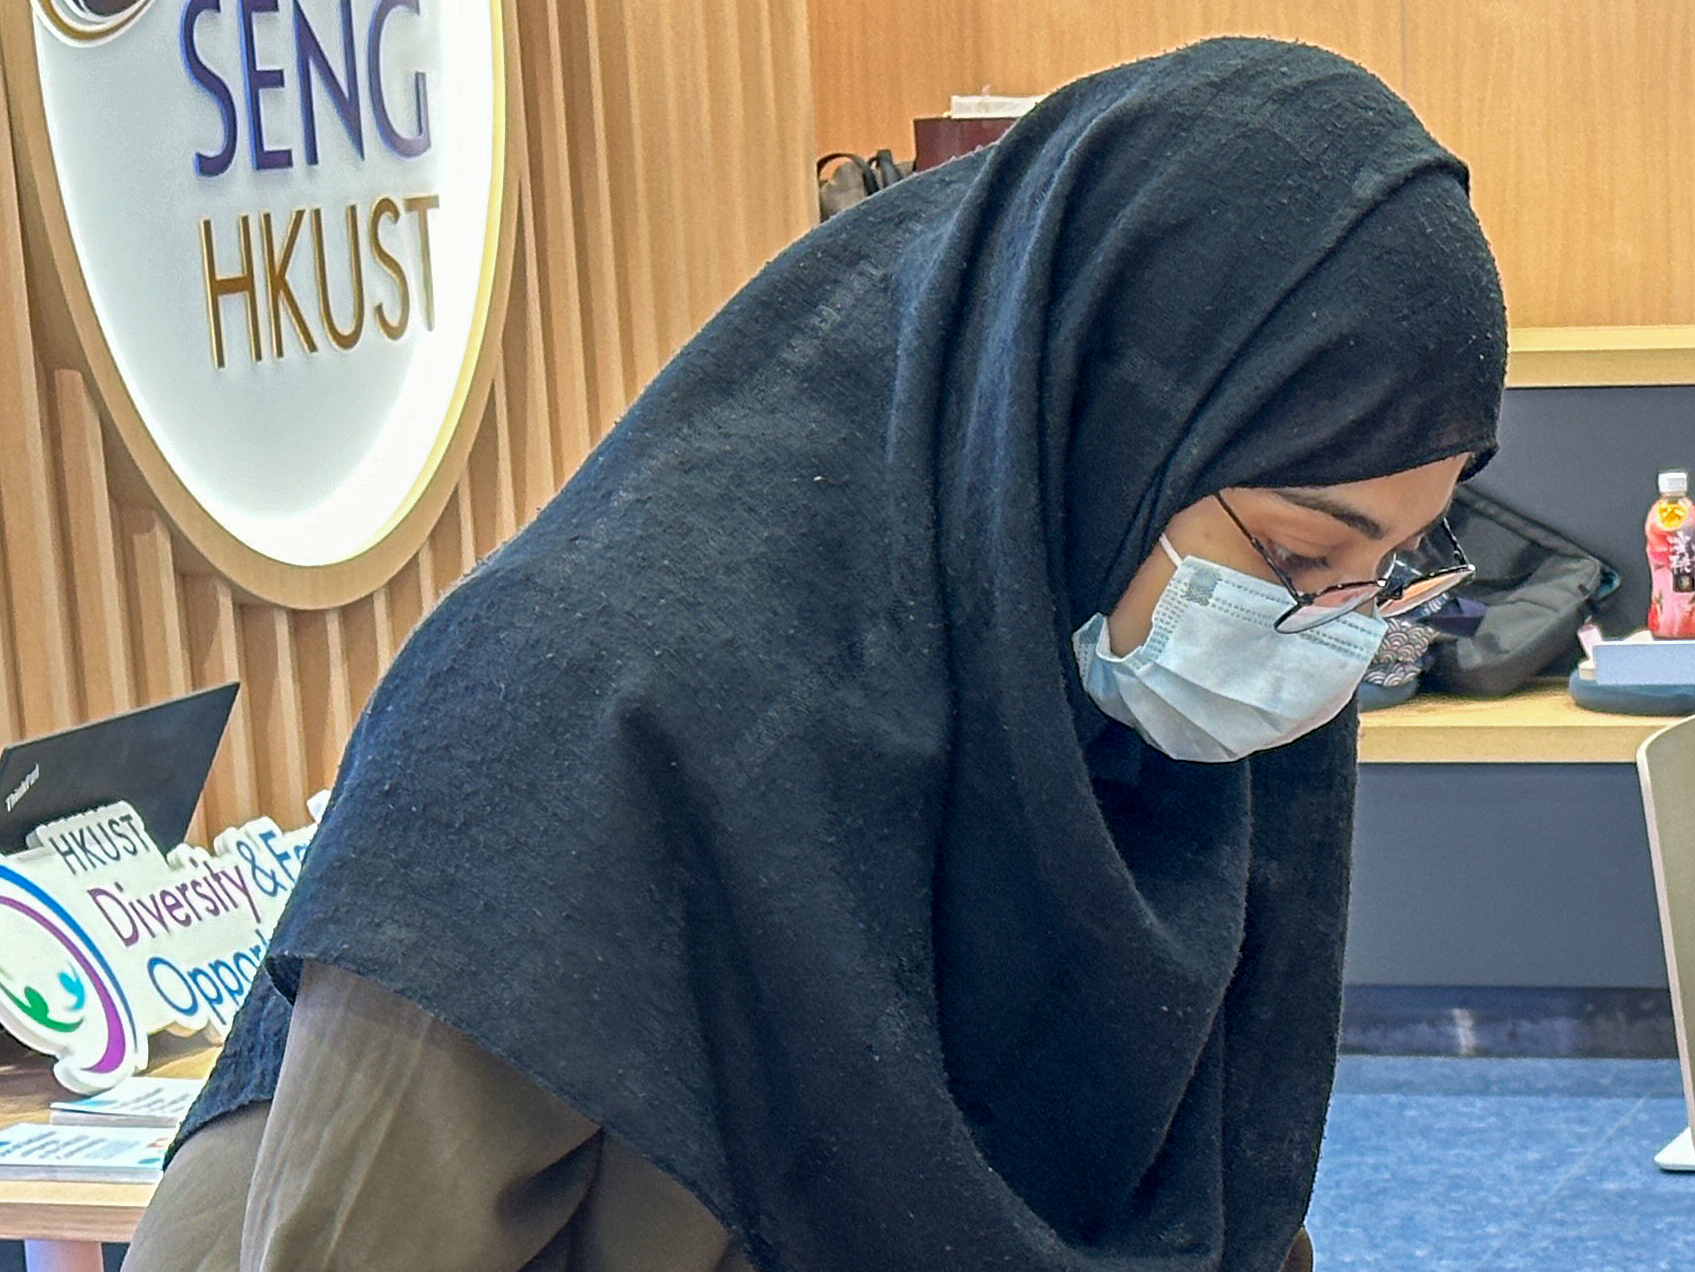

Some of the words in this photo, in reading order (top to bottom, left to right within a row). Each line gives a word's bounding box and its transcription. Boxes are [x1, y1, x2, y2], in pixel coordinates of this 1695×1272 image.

[179, 0, 432, 178] SENG
[200, 194, 440, 369] HKUST
[48, 814, 151, 875] HKUST
[87, 855, 262, 947] Diversity
[236, 840, 288, 897] &
